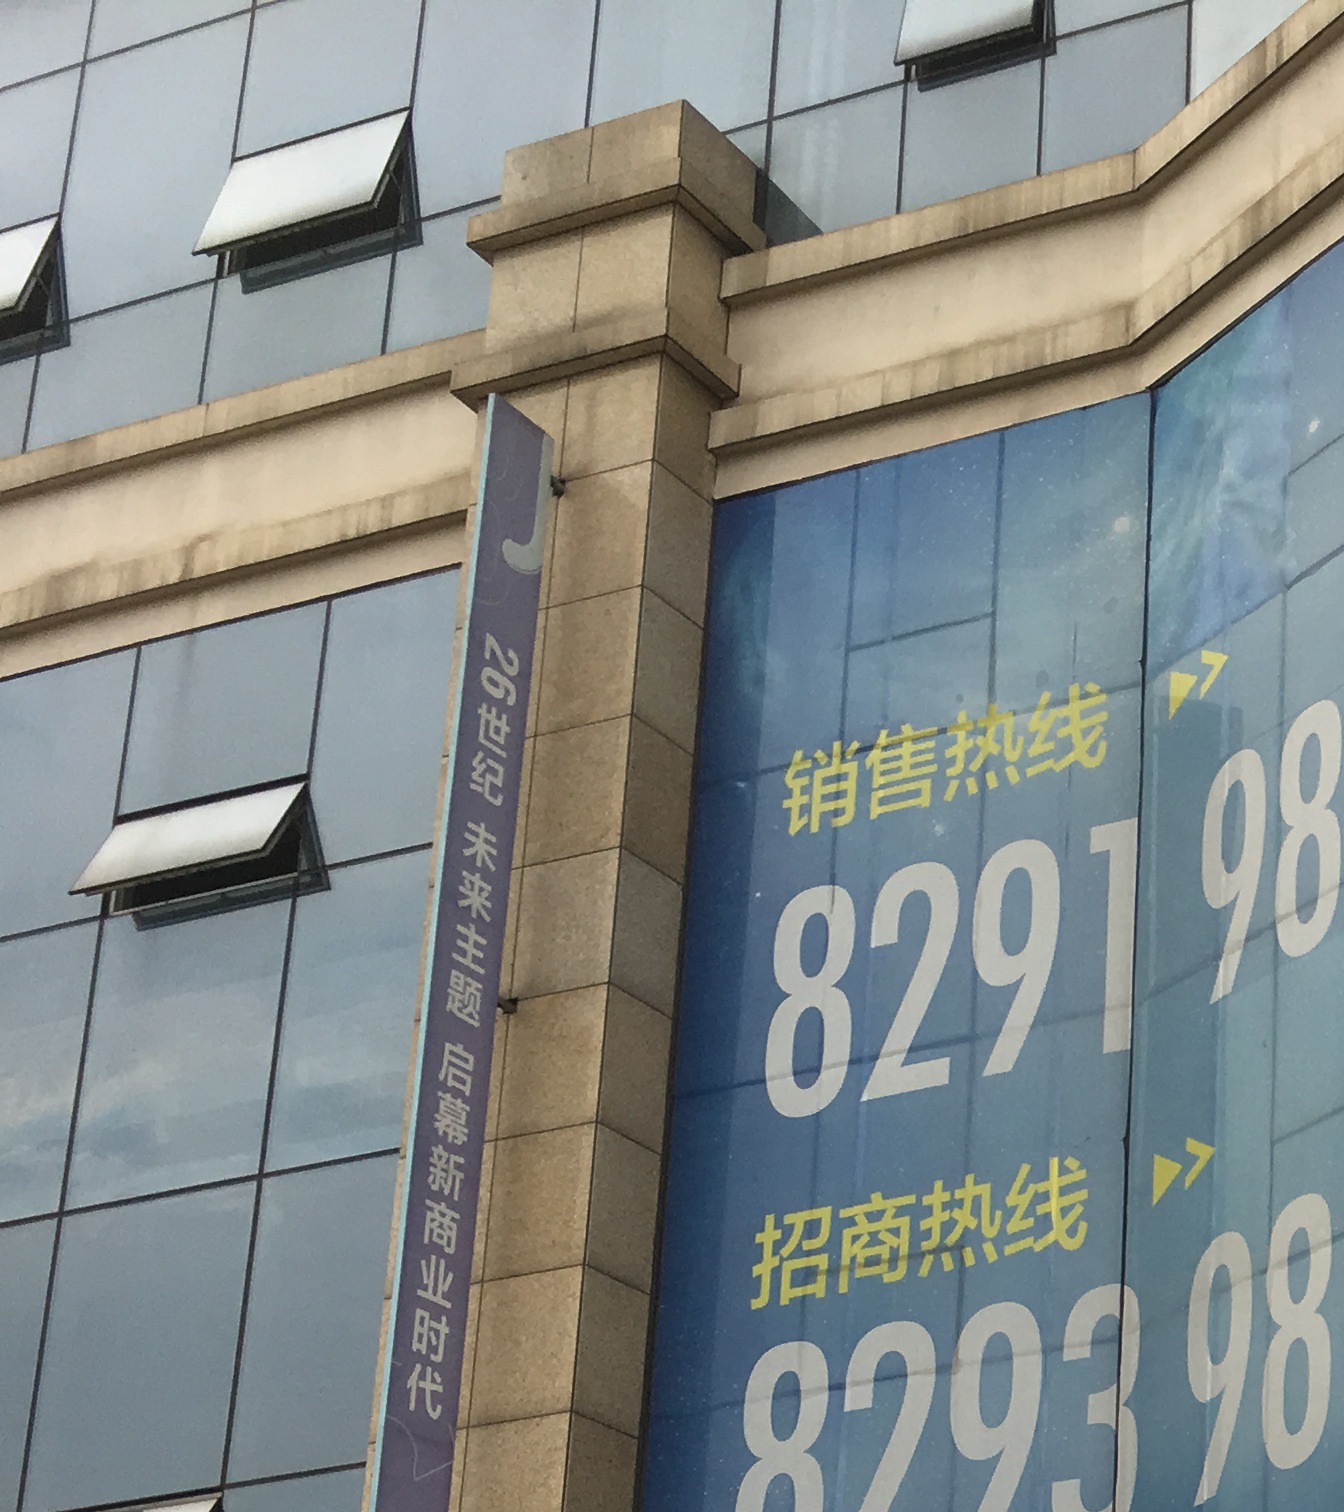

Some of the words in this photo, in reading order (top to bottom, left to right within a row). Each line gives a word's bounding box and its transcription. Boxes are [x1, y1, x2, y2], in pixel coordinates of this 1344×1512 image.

[468, 632, 521, 808] 26世纪
[781, 682, 1110, 837] 销售热线
[445, 820, 498, 1029] 未来主题
[764, 815, 1139, 1119] 8291
[406, 1041, 475, 1421] 启幕新商业时代
[750, 1155, 1090, 1312] 招商热线
